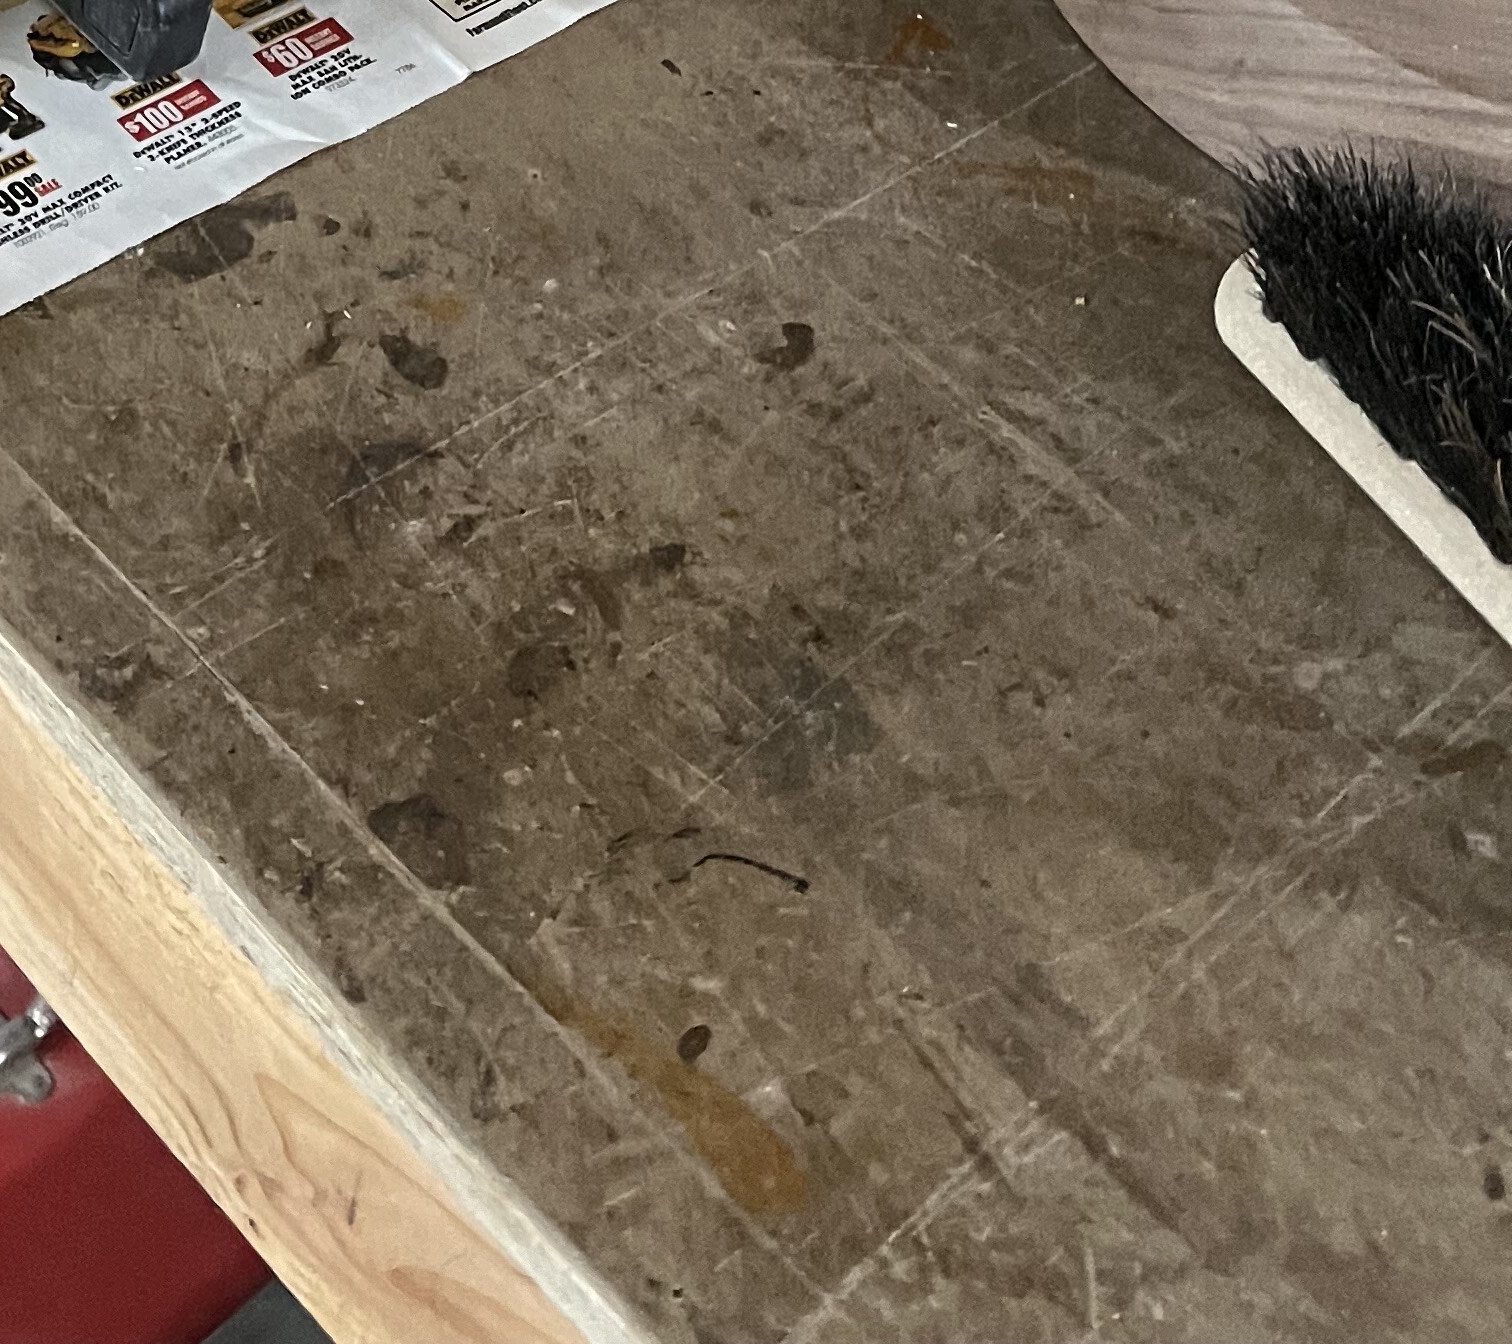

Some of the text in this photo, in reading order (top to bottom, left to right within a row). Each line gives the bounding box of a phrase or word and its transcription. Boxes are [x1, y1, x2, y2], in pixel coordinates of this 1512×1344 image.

[262, 37, 314, 69] $60
[125, 100, 184, 134] $100
[68, 173, 114, 200] COMPACT
